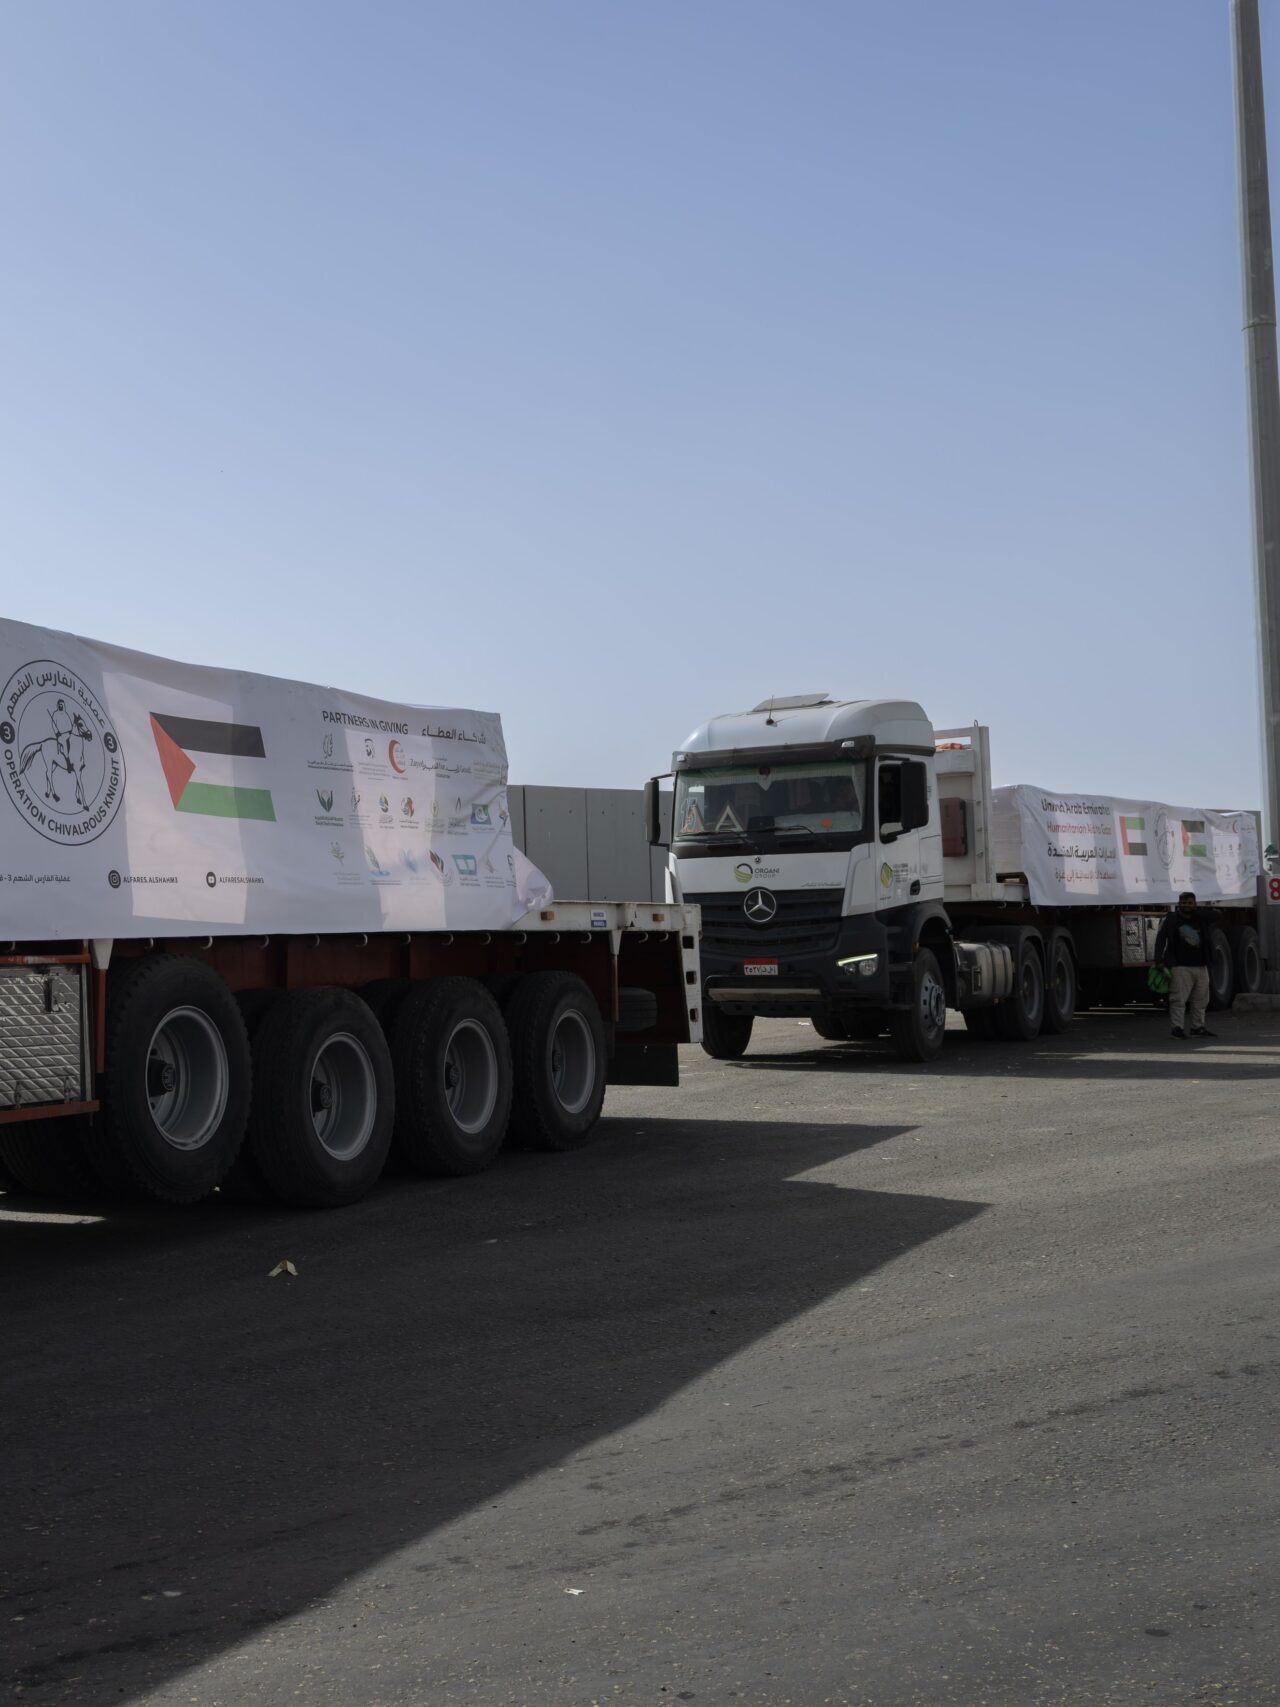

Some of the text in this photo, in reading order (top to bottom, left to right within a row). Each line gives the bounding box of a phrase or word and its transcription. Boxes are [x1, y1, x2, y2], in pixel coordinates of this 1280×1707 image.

[7, 671, 106, 729] عملية الفارس الشهم
[322, 710, 409, 735] PARTNERS IN GIVING
[422, 724, 457, 740] العطاء
[4, 749, 120, 837] OPERATION CHIVALROUS KNIGHT
[1269, 878, 1280, 901] 8
